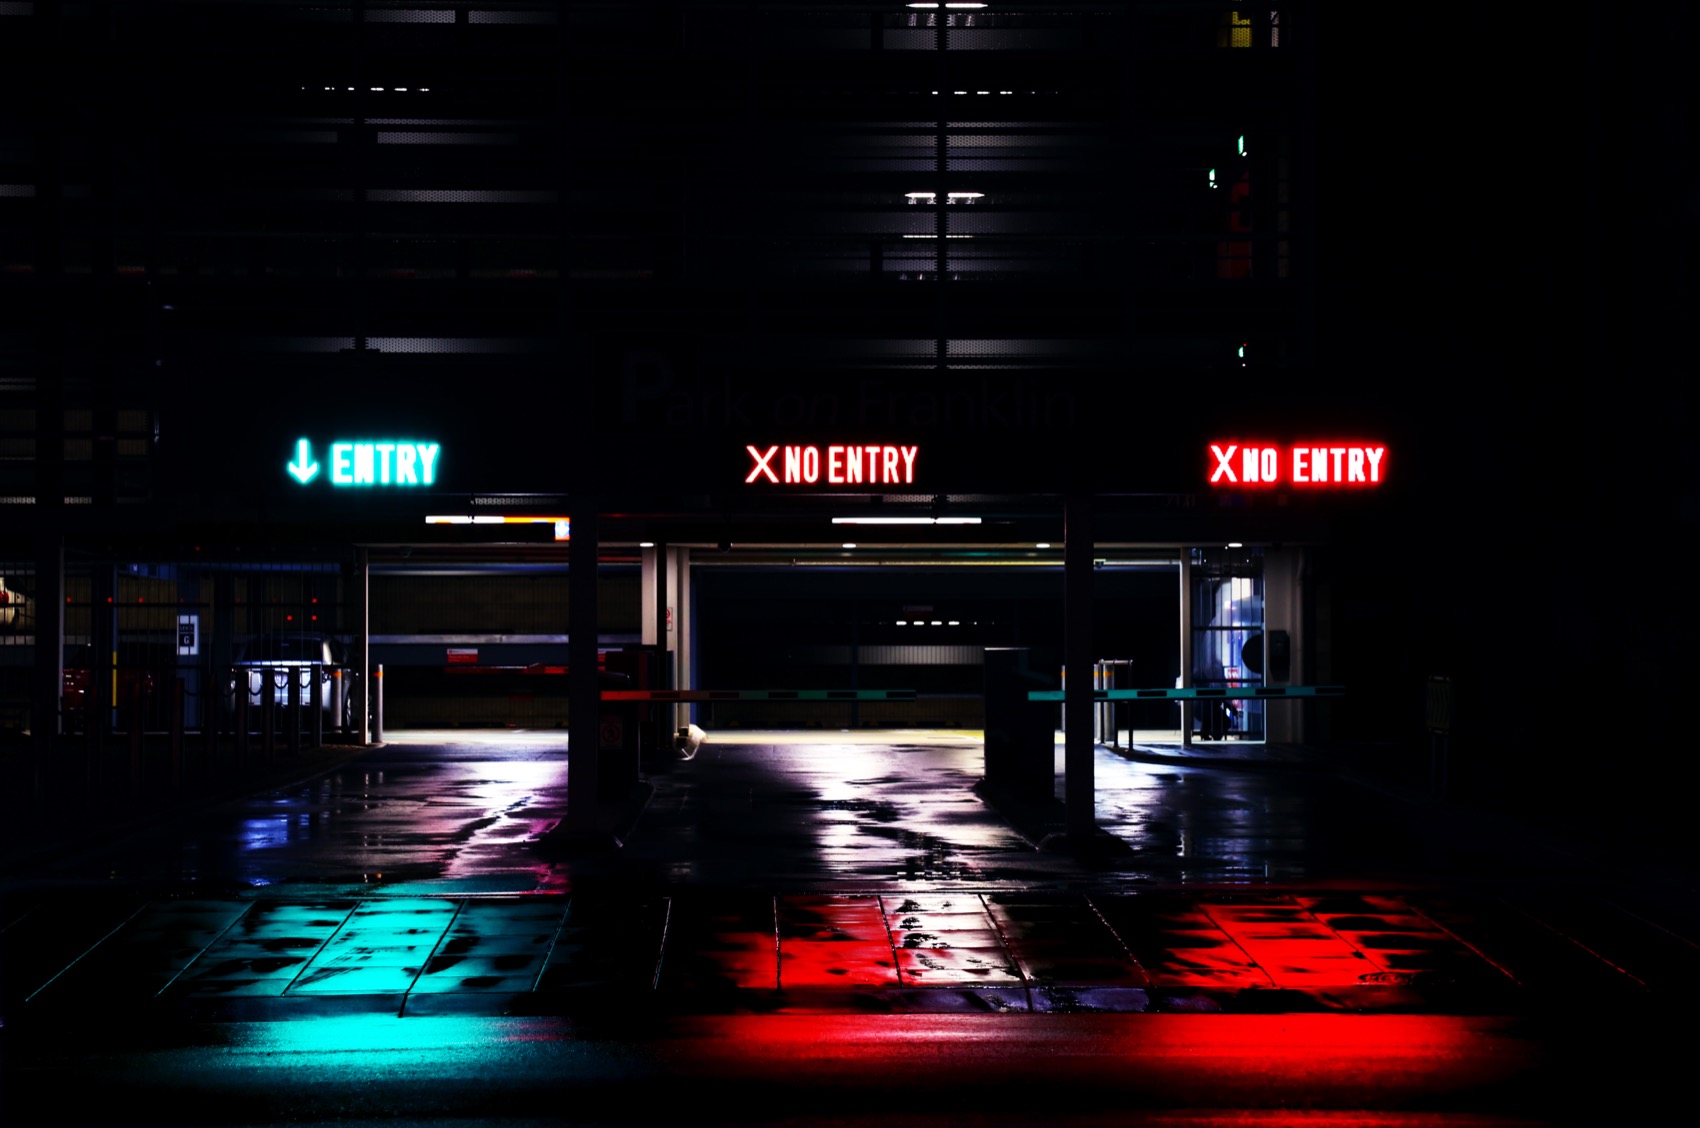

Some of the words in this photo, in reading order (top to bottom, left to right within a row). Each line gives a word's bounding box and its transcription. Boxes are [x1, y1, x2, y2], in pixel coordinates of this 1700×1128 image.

[622, 350, 752, 427] Park
[773, 388, 839, 427] on
[859, 375, 1077, 427] Franklin
[332, 442, 439, 484] ENTRY
[785, 446, 818, 483] NO
[828, 446, 917, 483] ENTRY
[1242, 446, 1278, 483] NO
[1293, 446, 1384, 483] ENTRY
